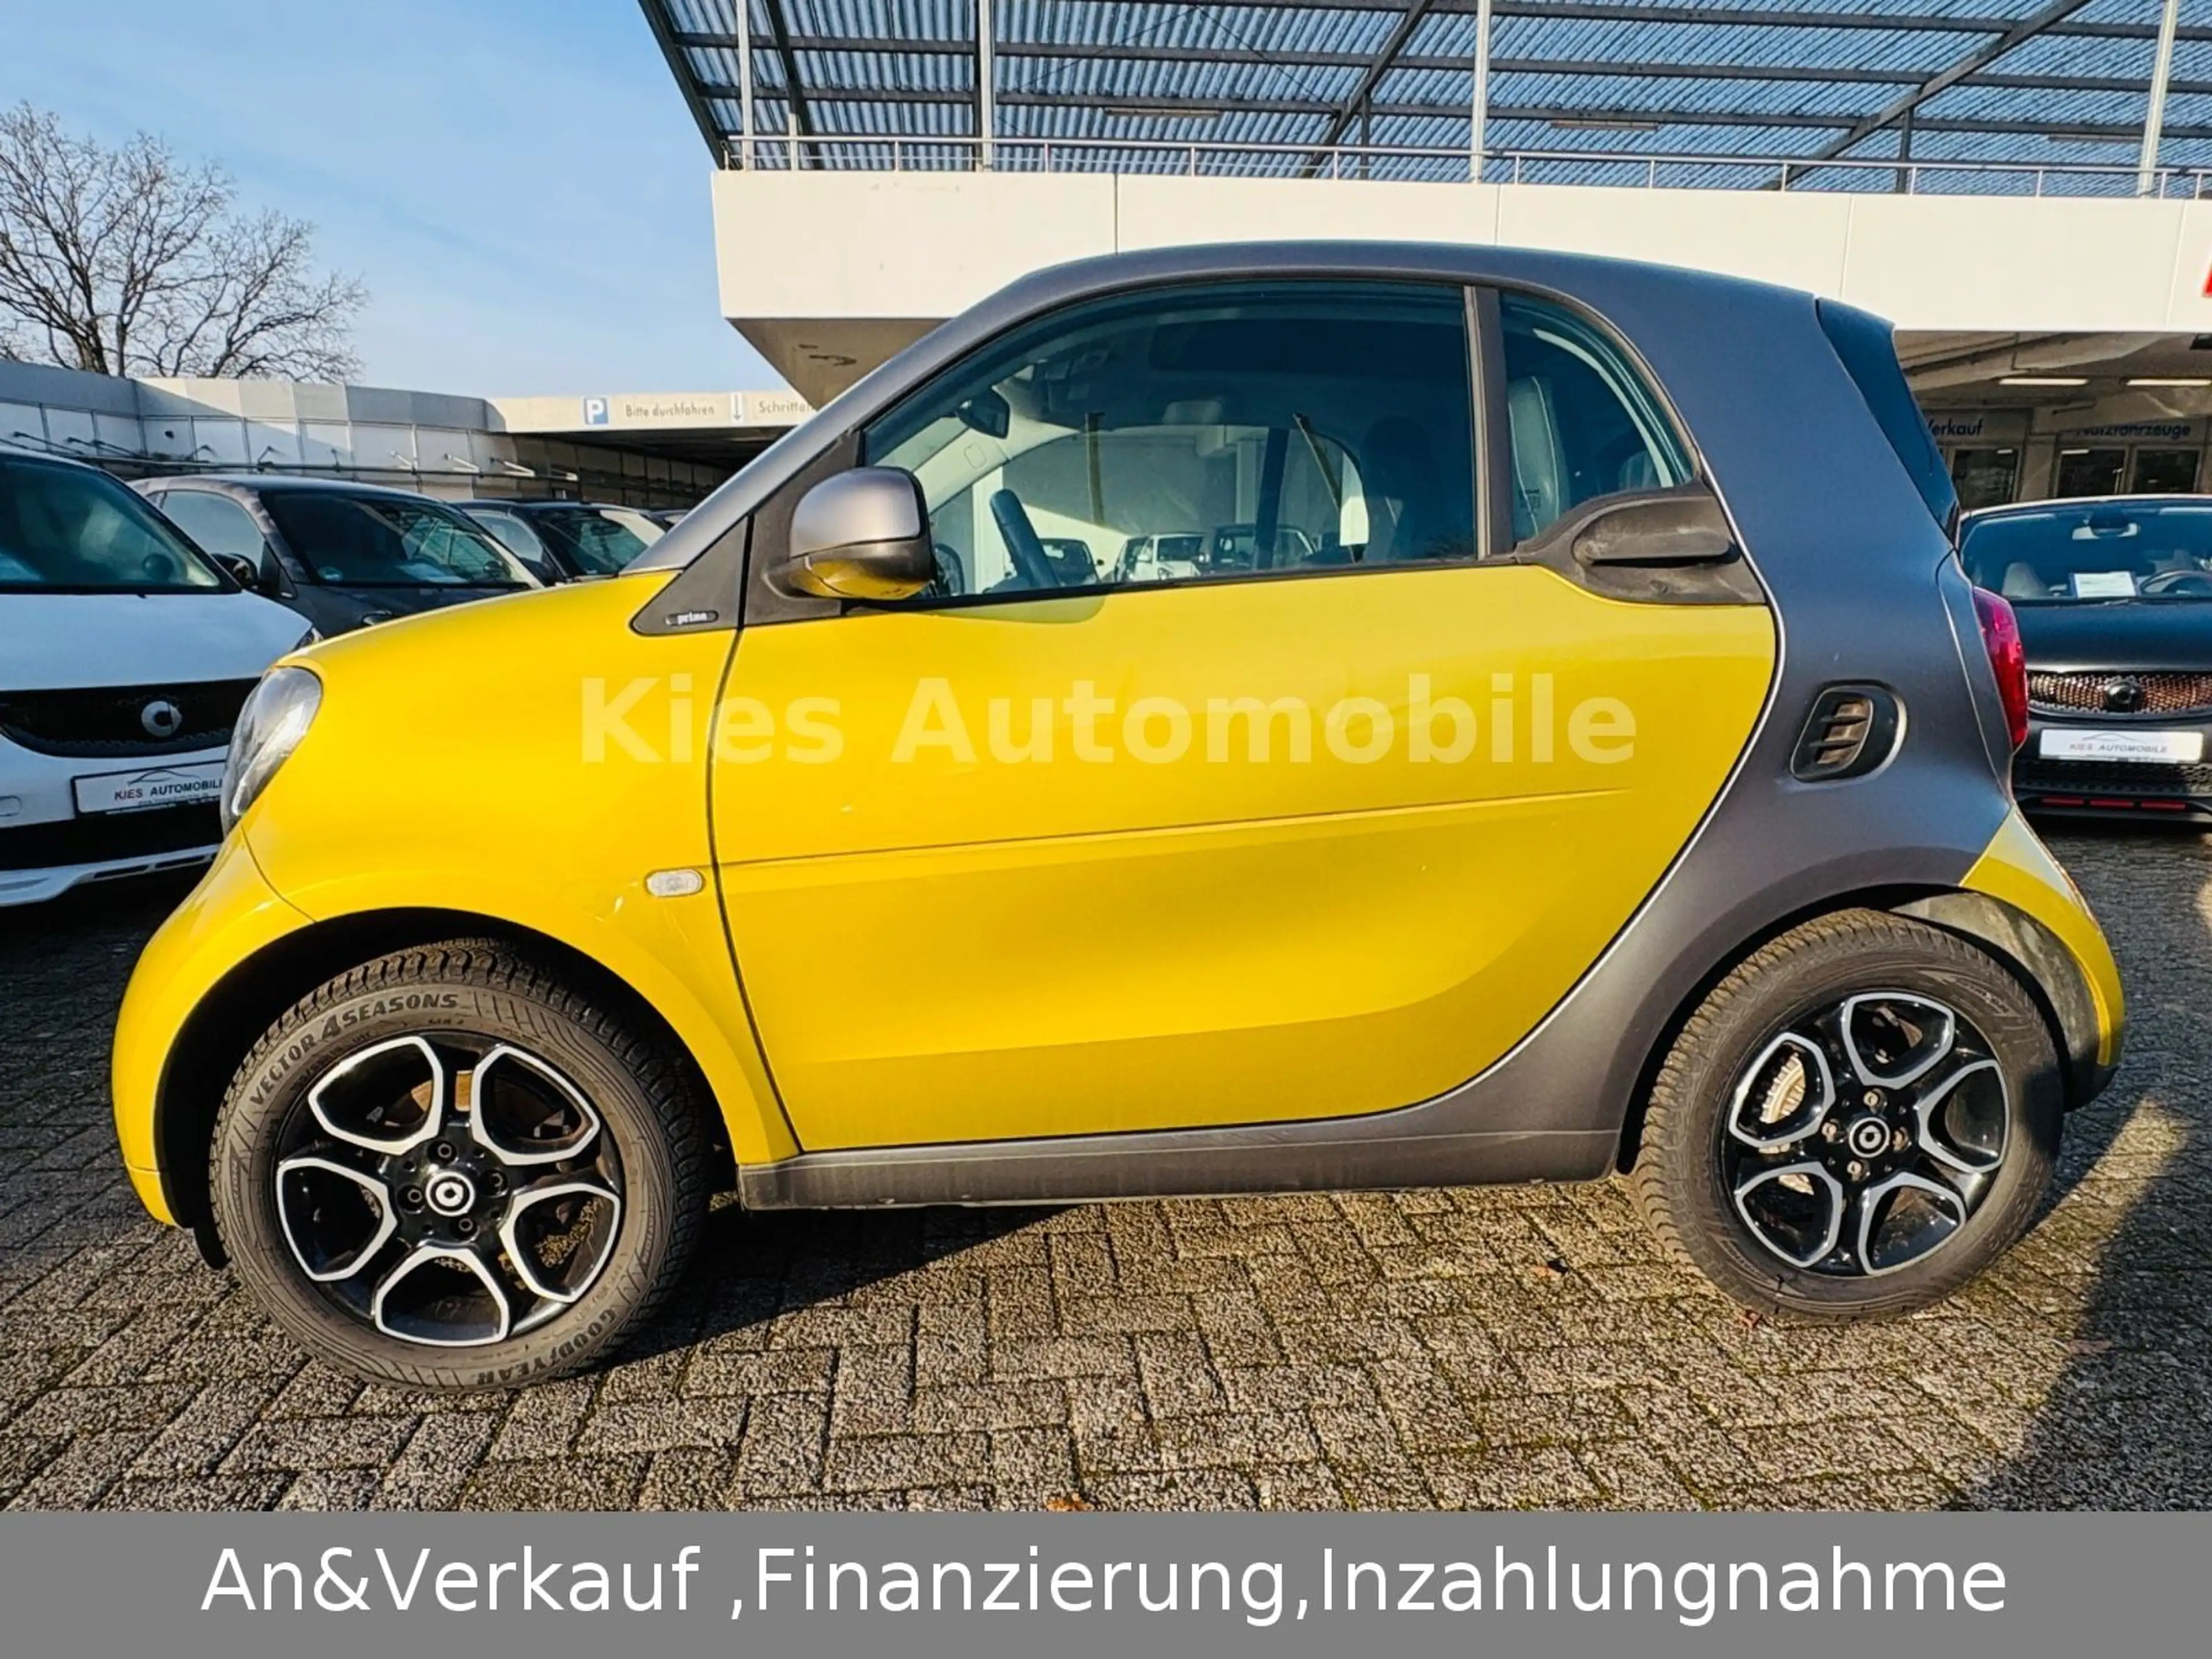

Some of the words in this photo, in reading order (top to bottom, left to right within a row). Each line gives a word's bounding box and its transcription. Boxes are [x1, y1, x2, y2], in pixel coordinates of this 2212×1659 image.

[587, 399, 604, 424] P
[626, 403, 649, 418] Bitte
[652, 402, 714, 416] durchfahren
[2099, 744, 2168, 753] AUTOMOBILE
[114, 788, 143, 801] KIES
[249, 1033, 317, 1105] VECTOR
[477, 1309, 617, 1385] GOODYEAR
